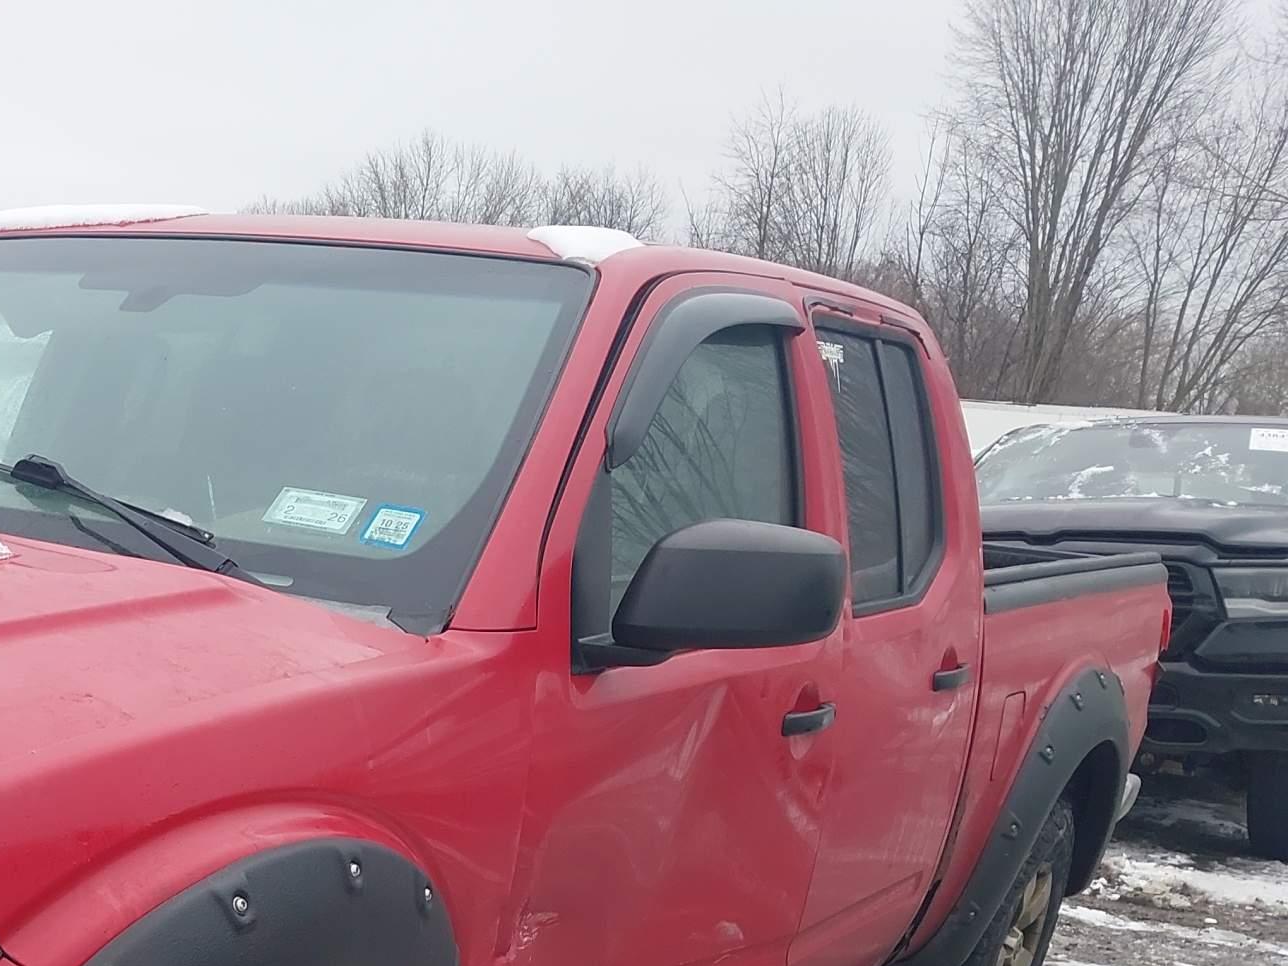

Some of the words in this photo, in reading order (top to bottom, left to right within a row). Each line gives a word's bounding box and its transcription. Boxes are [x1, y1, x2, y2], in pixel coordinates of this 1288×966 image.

[283, 505, 296, 515] 2
[327, 512, 348, 523] 26
[380, 518, 393, 528] 10
[394, 520, 410, 530] 25
